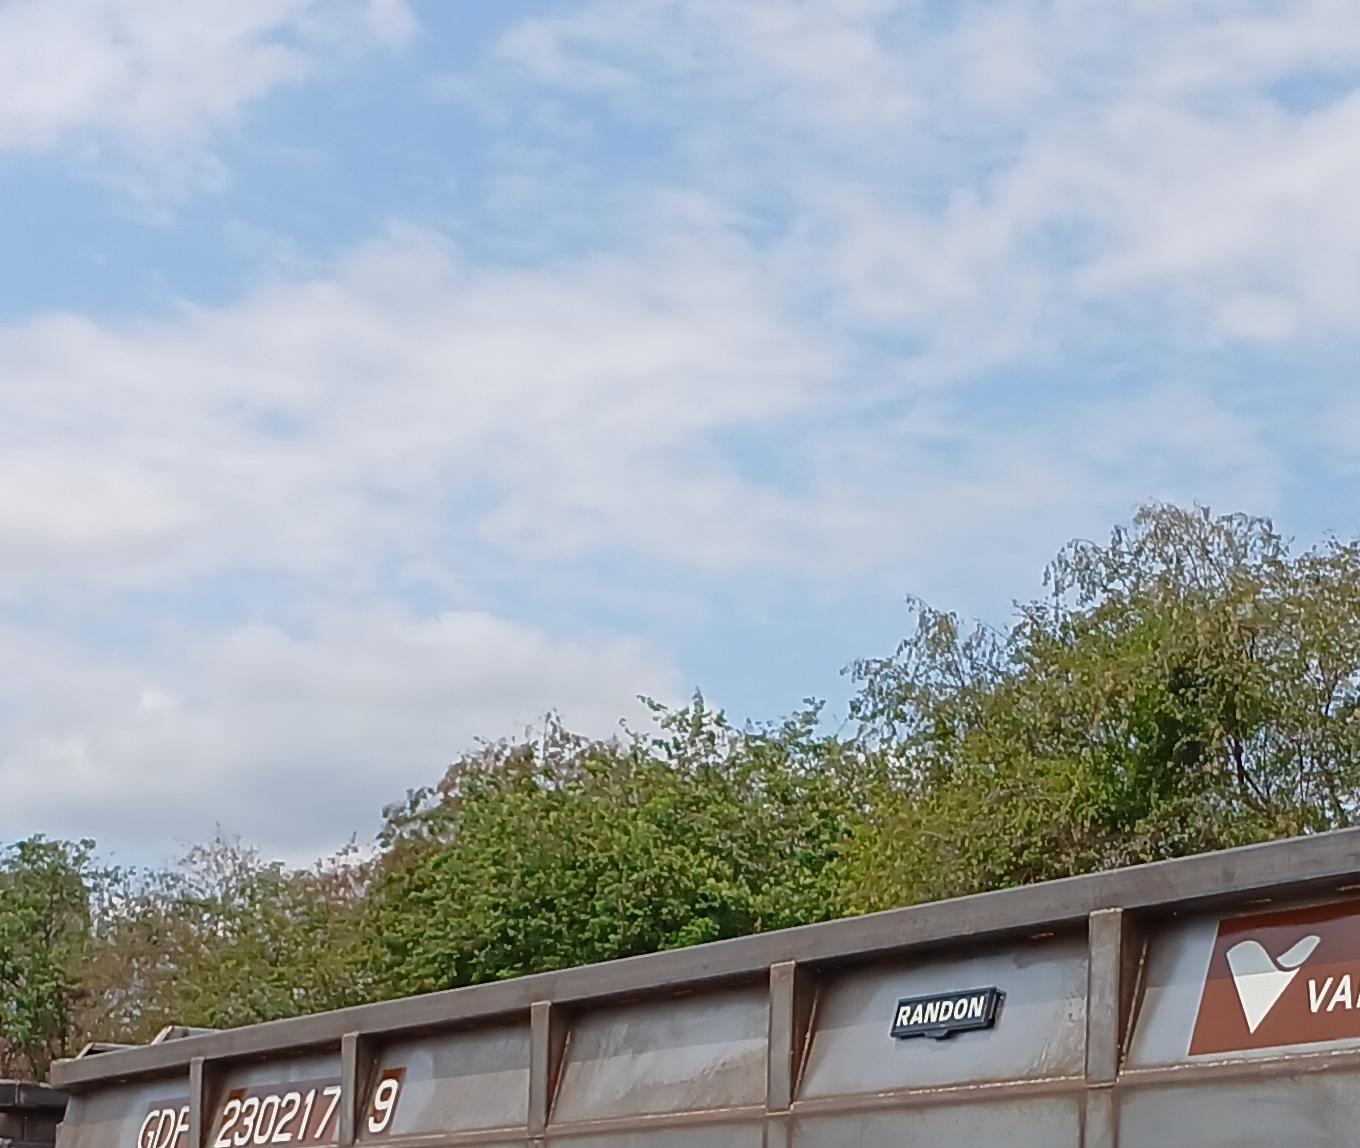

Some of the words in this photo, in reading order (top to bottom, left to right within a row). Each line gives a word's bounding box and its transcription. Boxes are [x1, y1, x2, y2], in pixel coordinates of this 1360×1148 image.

[896, 996, 985, 1027] RANDON
[213, 1085, 342, 1148] 230217
[368, 1078, 400, 1133] 9
